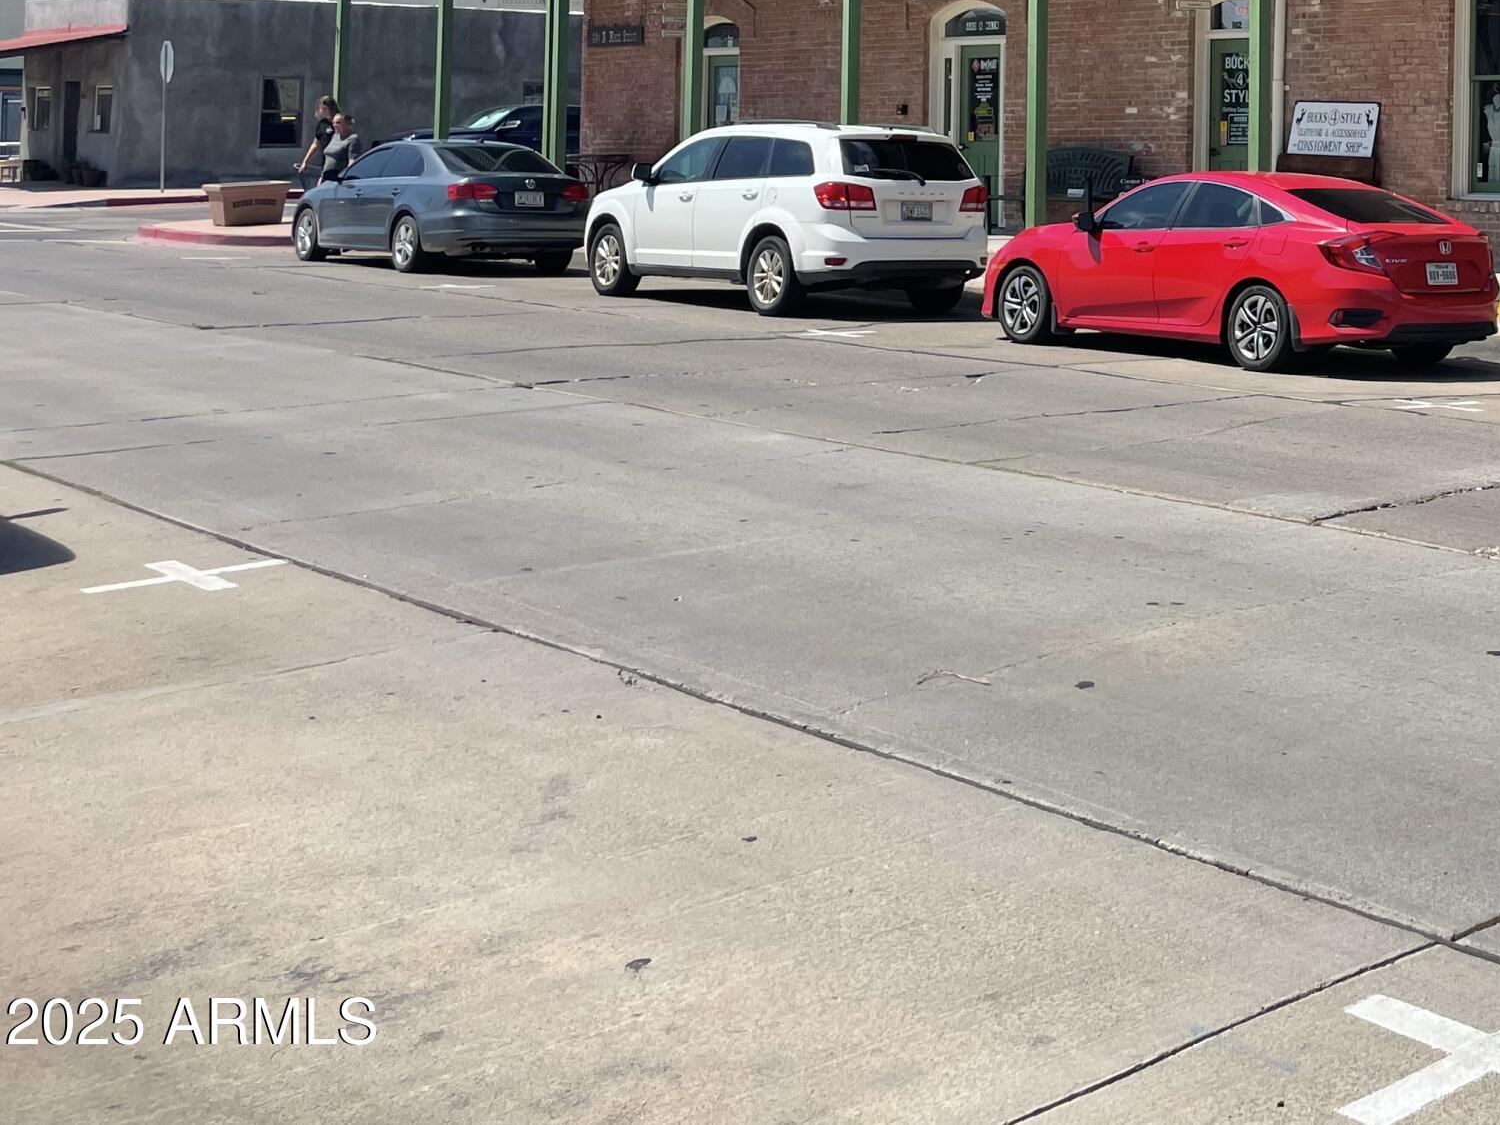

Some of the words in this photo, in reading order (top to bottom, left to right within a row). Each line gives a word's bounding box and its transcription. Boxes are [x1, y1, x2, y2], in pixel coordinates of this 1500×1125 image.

[1225, 56, 1249, 69] BUCK
[1236, 74, 1243, 86] 4
[1223, 89, 1249, 103] STYL
[1307, 113, 1327, 123] BUCKS
[1339, 113, 1361, 124] STYLE
[1297, 128, 1323, 137] CLOTHING
[1330, 129, 1368, 139] ACCESSORIES
